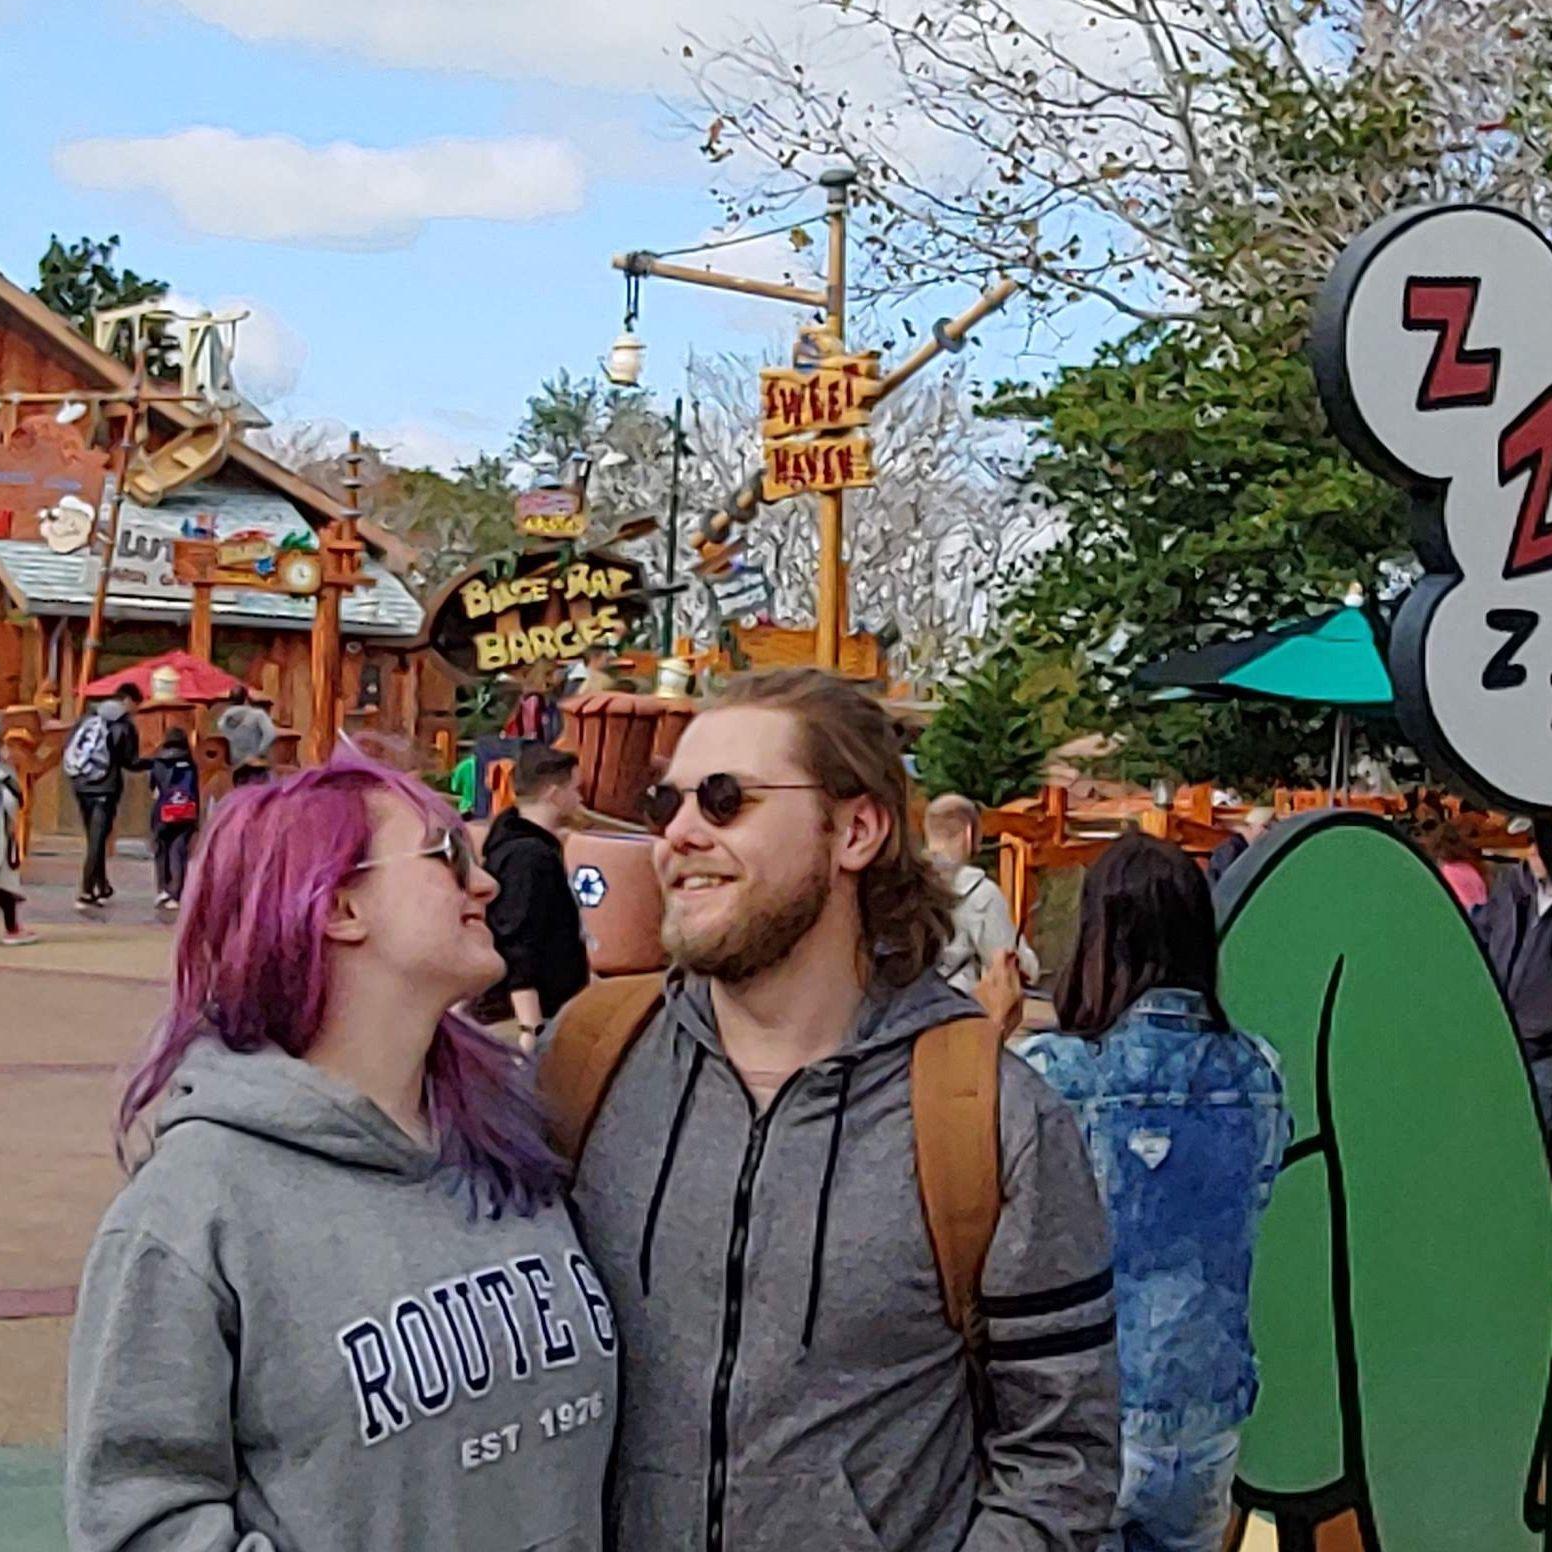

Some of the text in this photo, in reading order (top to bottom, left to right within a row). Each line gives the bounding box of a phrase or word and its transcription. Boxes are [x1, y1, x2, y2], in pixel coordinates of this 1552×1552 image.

[473, 604, 627, 672] BARGES
[337, 1253, 580, 1446] ROUTE
[460, 1423, 522, 1470] EST
